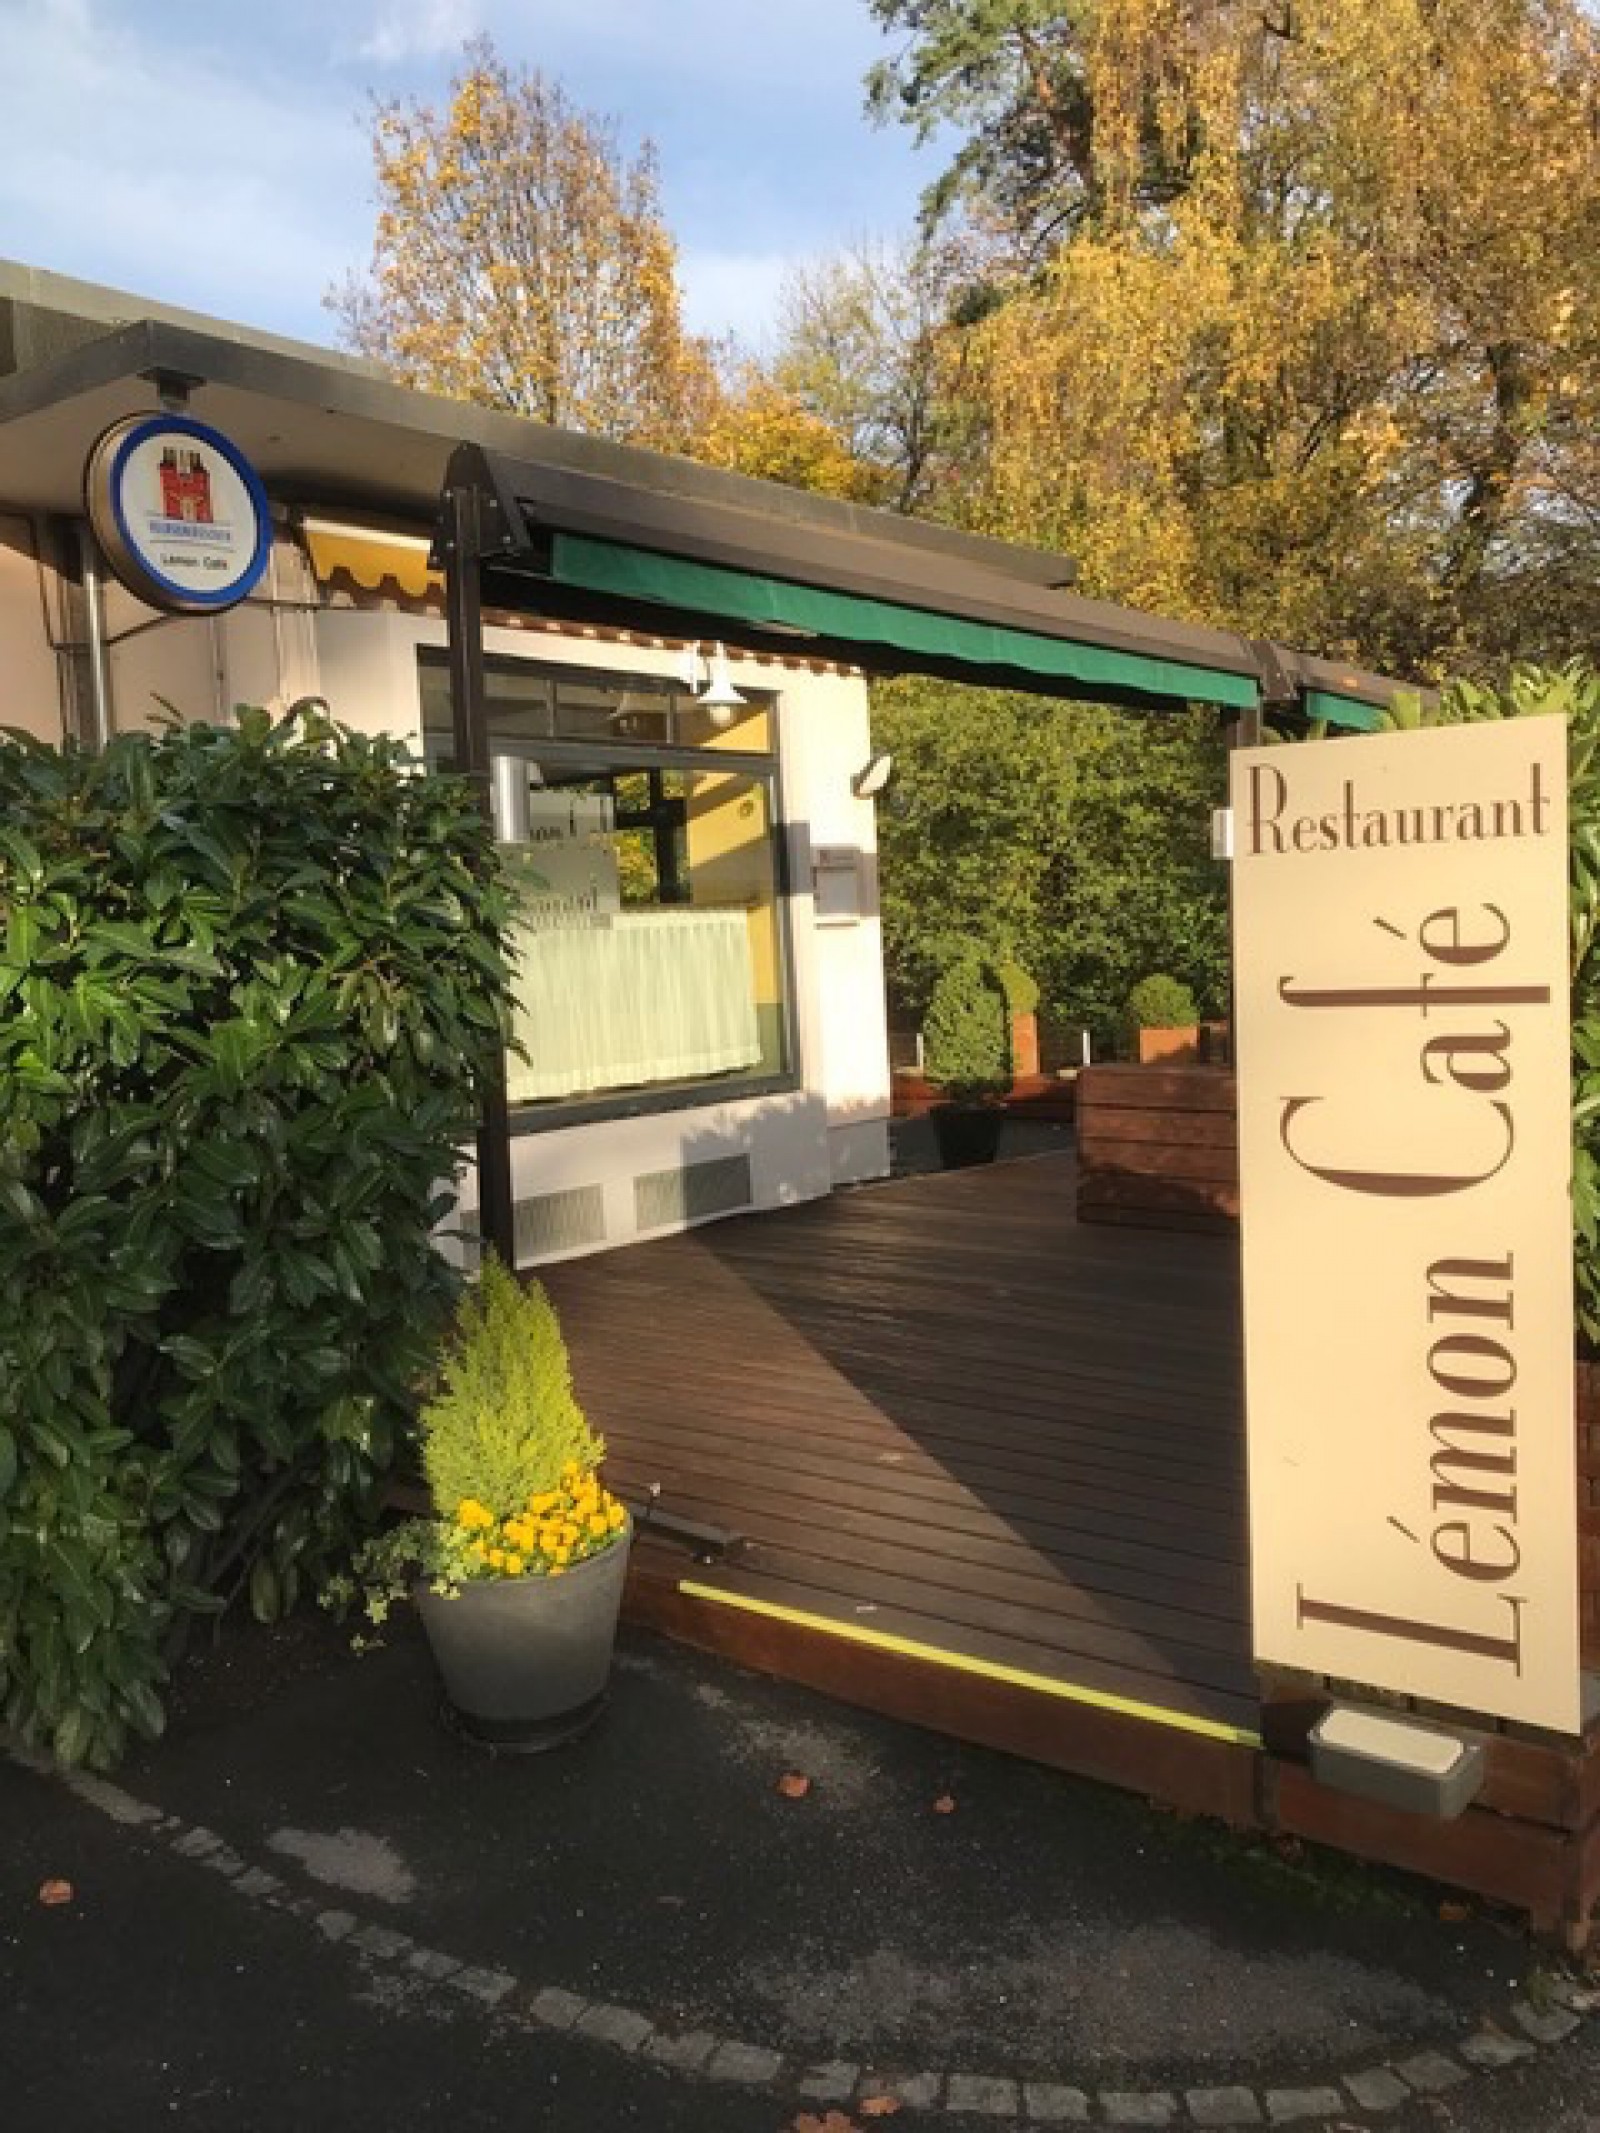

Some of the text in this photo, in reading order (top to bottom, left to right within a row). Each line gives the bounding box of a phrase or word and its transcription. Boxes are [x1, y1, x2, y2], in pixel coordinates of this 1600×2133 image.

[1246, 762, 1551, 856] Restaurant
[1278, 902, 1551, 1678] Lémon Café
